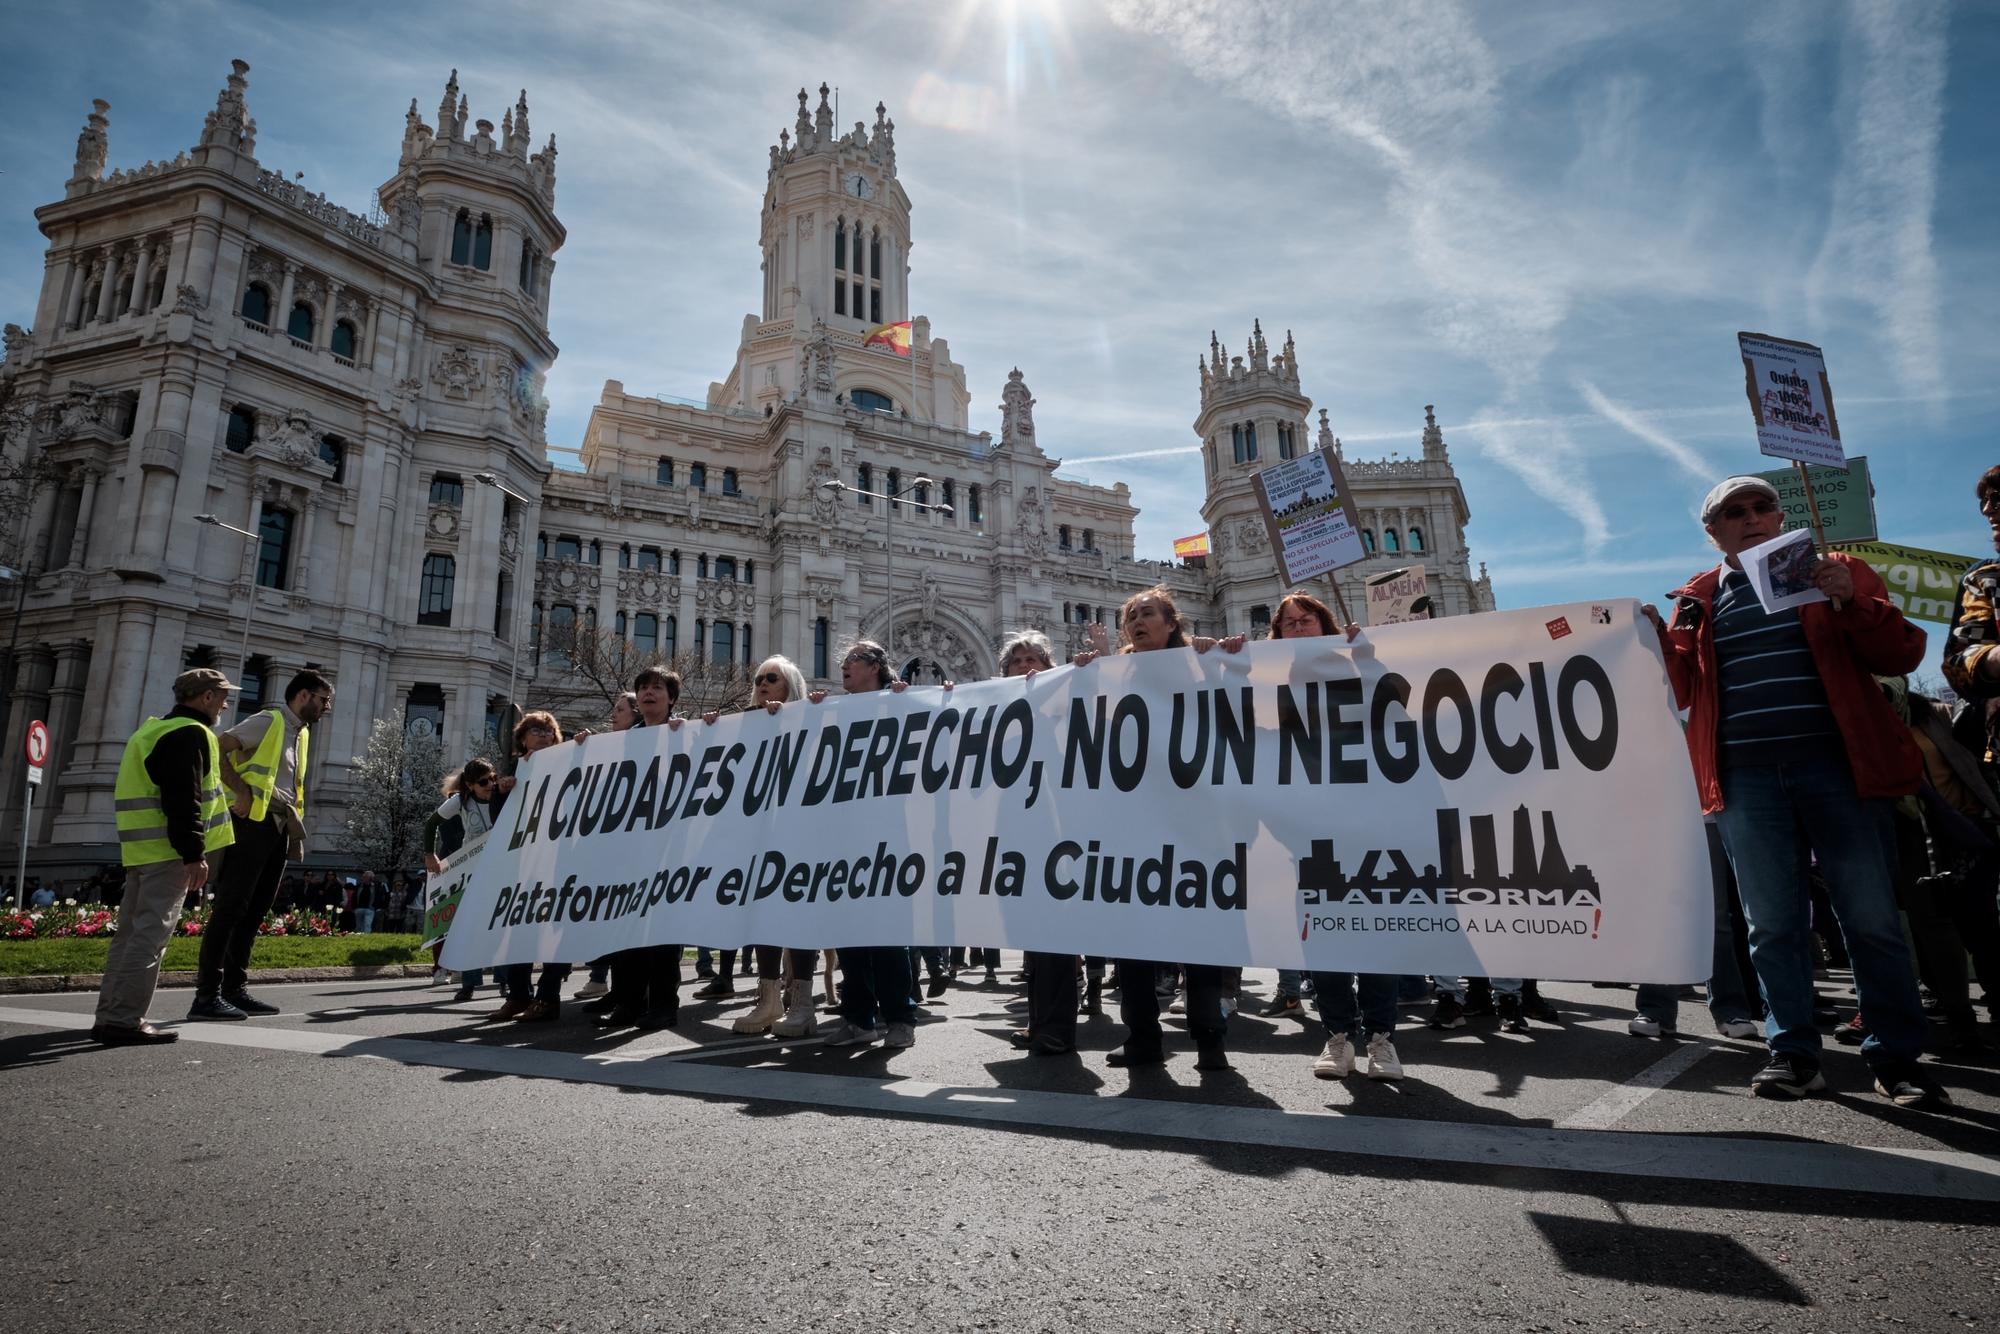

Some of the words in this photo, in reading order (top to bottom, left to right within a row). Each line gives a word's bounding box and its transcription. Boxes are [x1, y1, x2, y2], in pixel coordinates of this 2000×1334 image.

[1769, 370, 1809, 388] Quinta
[1773, 407, 1820, 427] Pública
[1758, 430, 1780, 440] Contra
[1790, 436, 1834, 450] privatización
[1770, 442, 1794, 453] Quinta
[1795, 447, 1804, 455] de
[1804, 448, 1823, 458] Torre
[1268, 485, 1284, 495] FUERA
[1291, 470, 1325, 487] ESPECULACIÓN
[1824, 468, 1850, 479] GRIS
[1277, 486, 1301, 498] NUESTROS
[1285, 551, 1296, 560] NO
[1297, 548, 1306, 556] SE
[1306, 536, 1339, 550] ESPECULA
[1339, 530, 1356, 540] CON
[1288, 553, 1320, 569] NUESTRA
[1291, 558, 1336, 579] NATURALEZA
[508, 774, 551, 851] LA
[742, 729, 808, 816] UN
[801, 697, 1044, 809] DERECHO,
[1061, 694, 1150, 792] NO
[1168, 686, 1256, 789] UN
[1277, 654, 1619, 785] NEGOCIO
[450, 854, 468, 870] MADRID
[639, 865, 712, 918] por
[752, 841, 926, 903] Derecho
[937, 850, 966, 897] a
[978, 836, 1027, 897] la
[1044, 840, 1247, 911] Ciudad
[1299, 887, 1601, 906] PLATAFORMA
[1351, 917, 1369, 931] EL
[1374, 917, 1460, 932] DERECHO
[1467, 918, 1479, 933] A
[1485, 919, 1507, 933] LA
